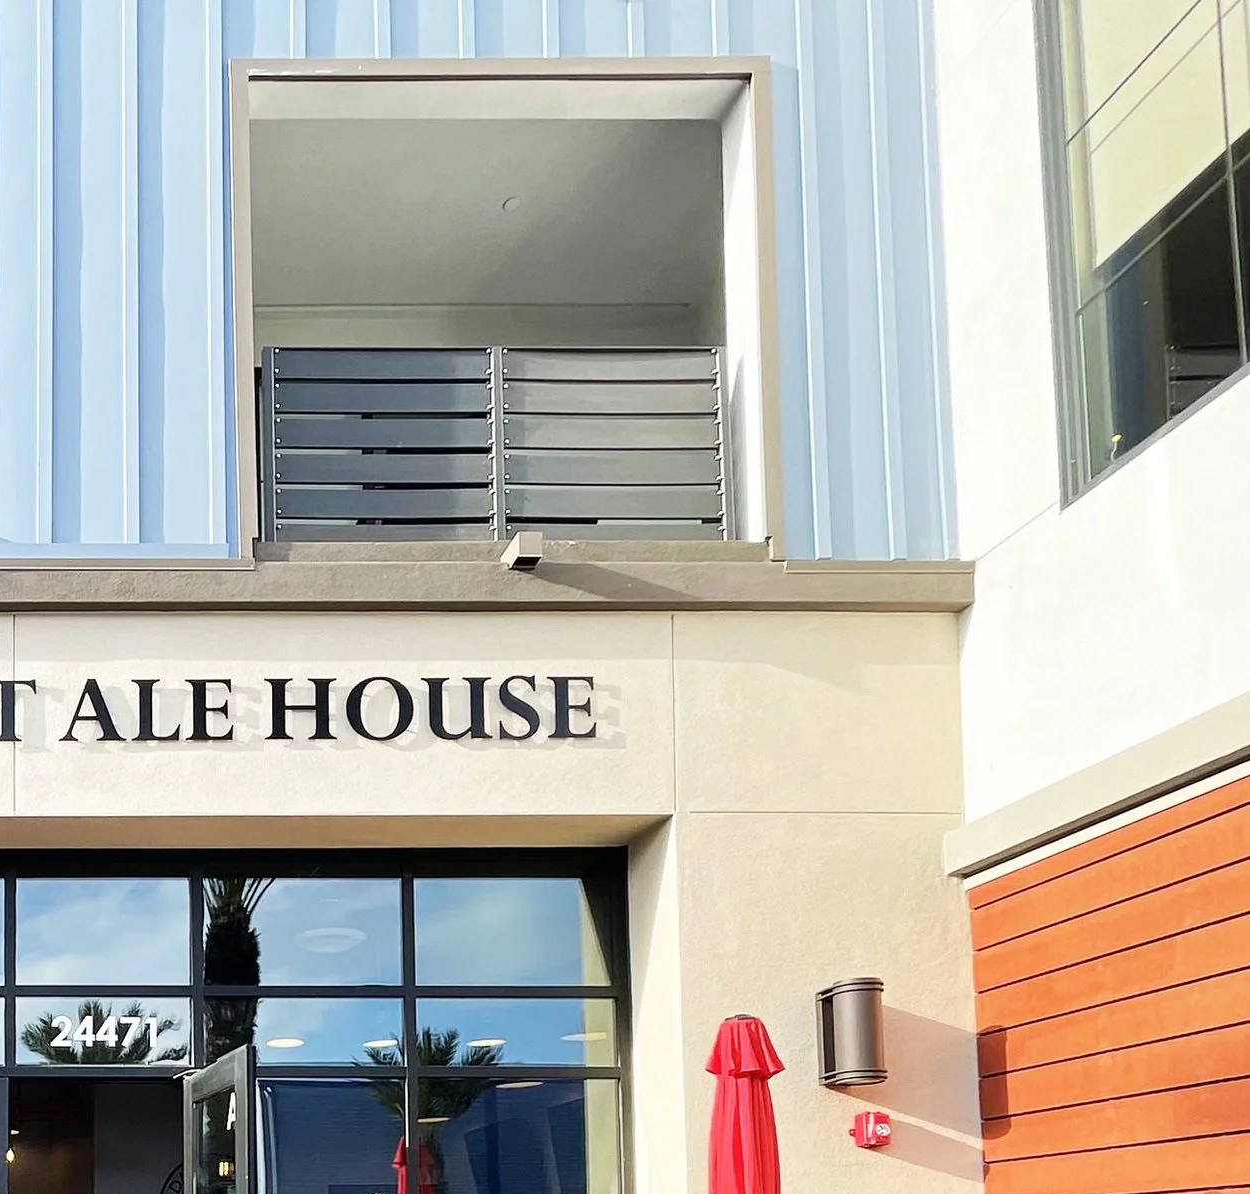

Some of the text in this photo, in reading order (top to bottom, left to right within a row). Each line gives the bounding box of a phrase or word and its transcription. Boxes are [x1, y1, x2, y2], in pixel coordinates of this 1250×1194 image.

[58, 677, 234, 742] ALE
[263, 675, 598, 742] HOUSE
[49, 1014, 159, 1048] 24471
